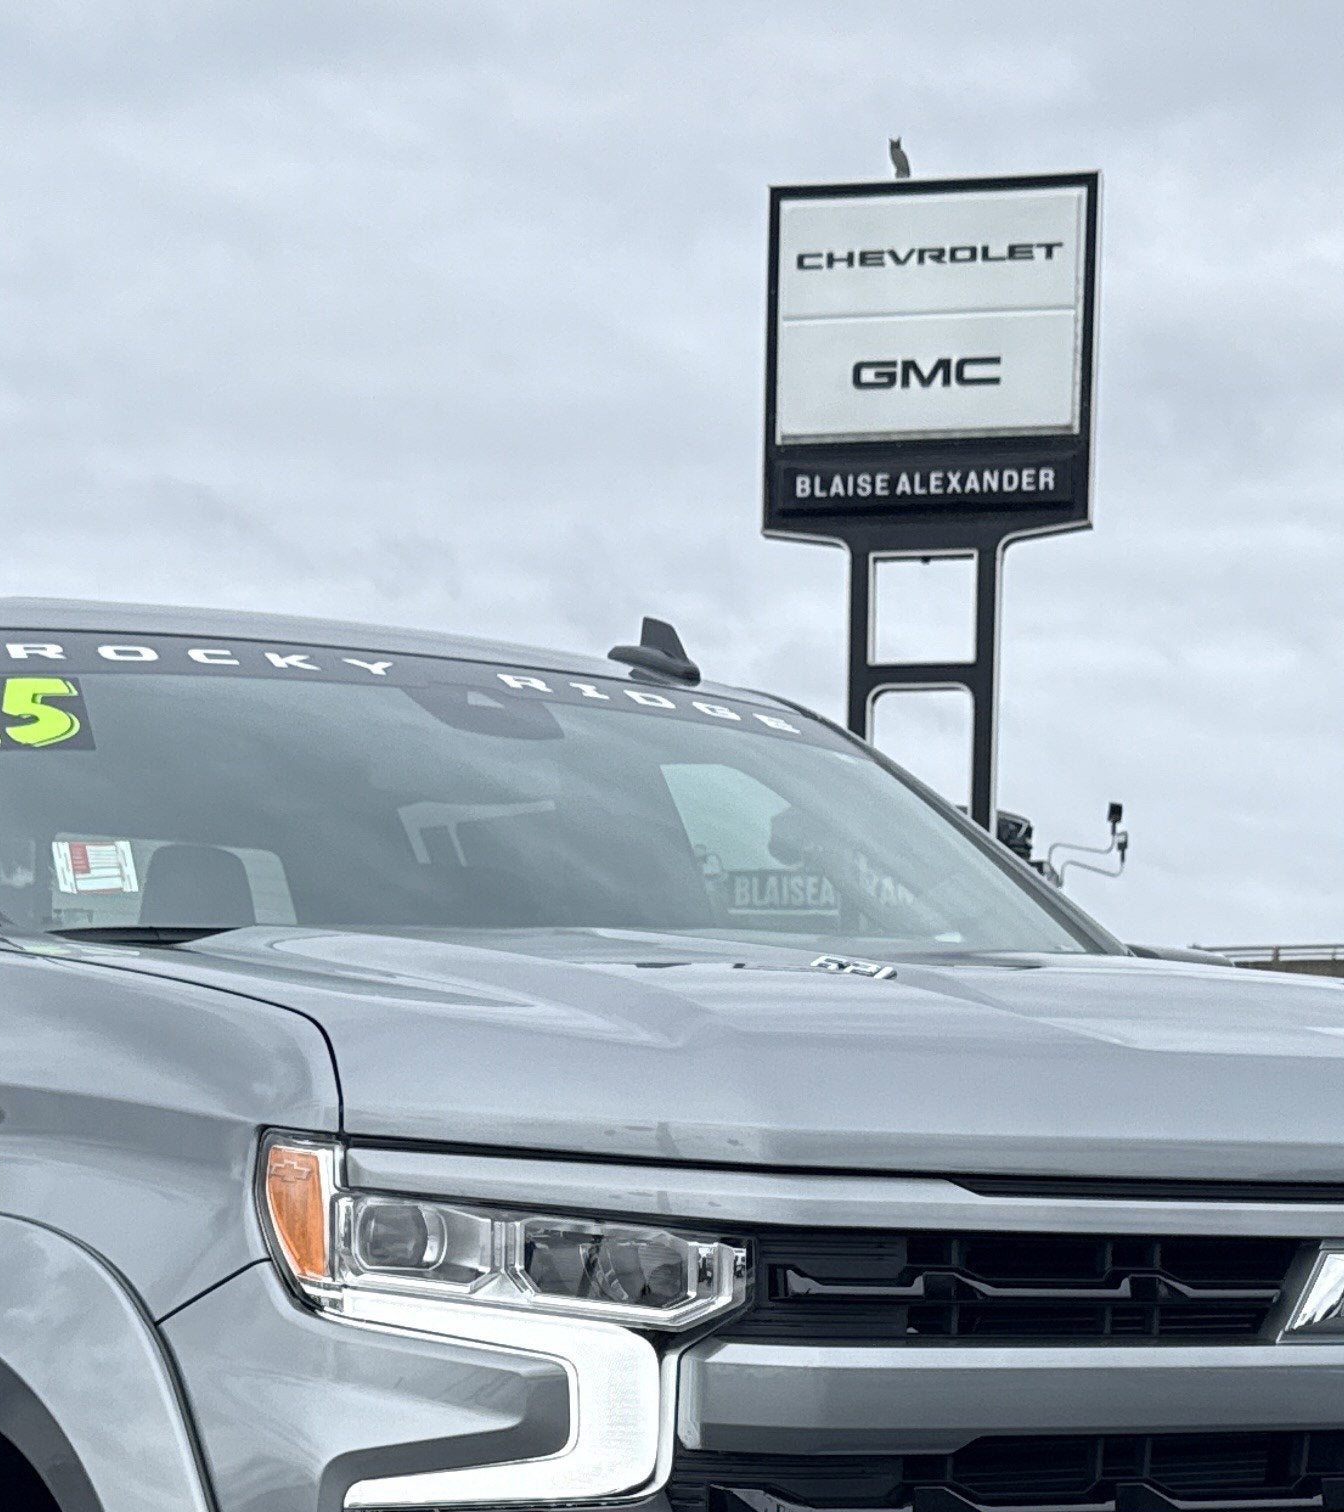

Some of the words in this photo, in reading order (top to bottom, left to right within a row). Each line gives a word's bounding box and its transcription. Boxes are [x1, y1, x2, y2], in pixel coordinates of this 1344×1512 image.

[796, 241, 1064, 270] CHEVROLET
[852, 356, 1002, 390] GMC
[795, 471, 891, 499] BLAISE
[895, 465, 1056, 497] ALEXANDER
[5, 642, 394, 677] ROCKY
[496, 673, 802, 735] RIDGE
